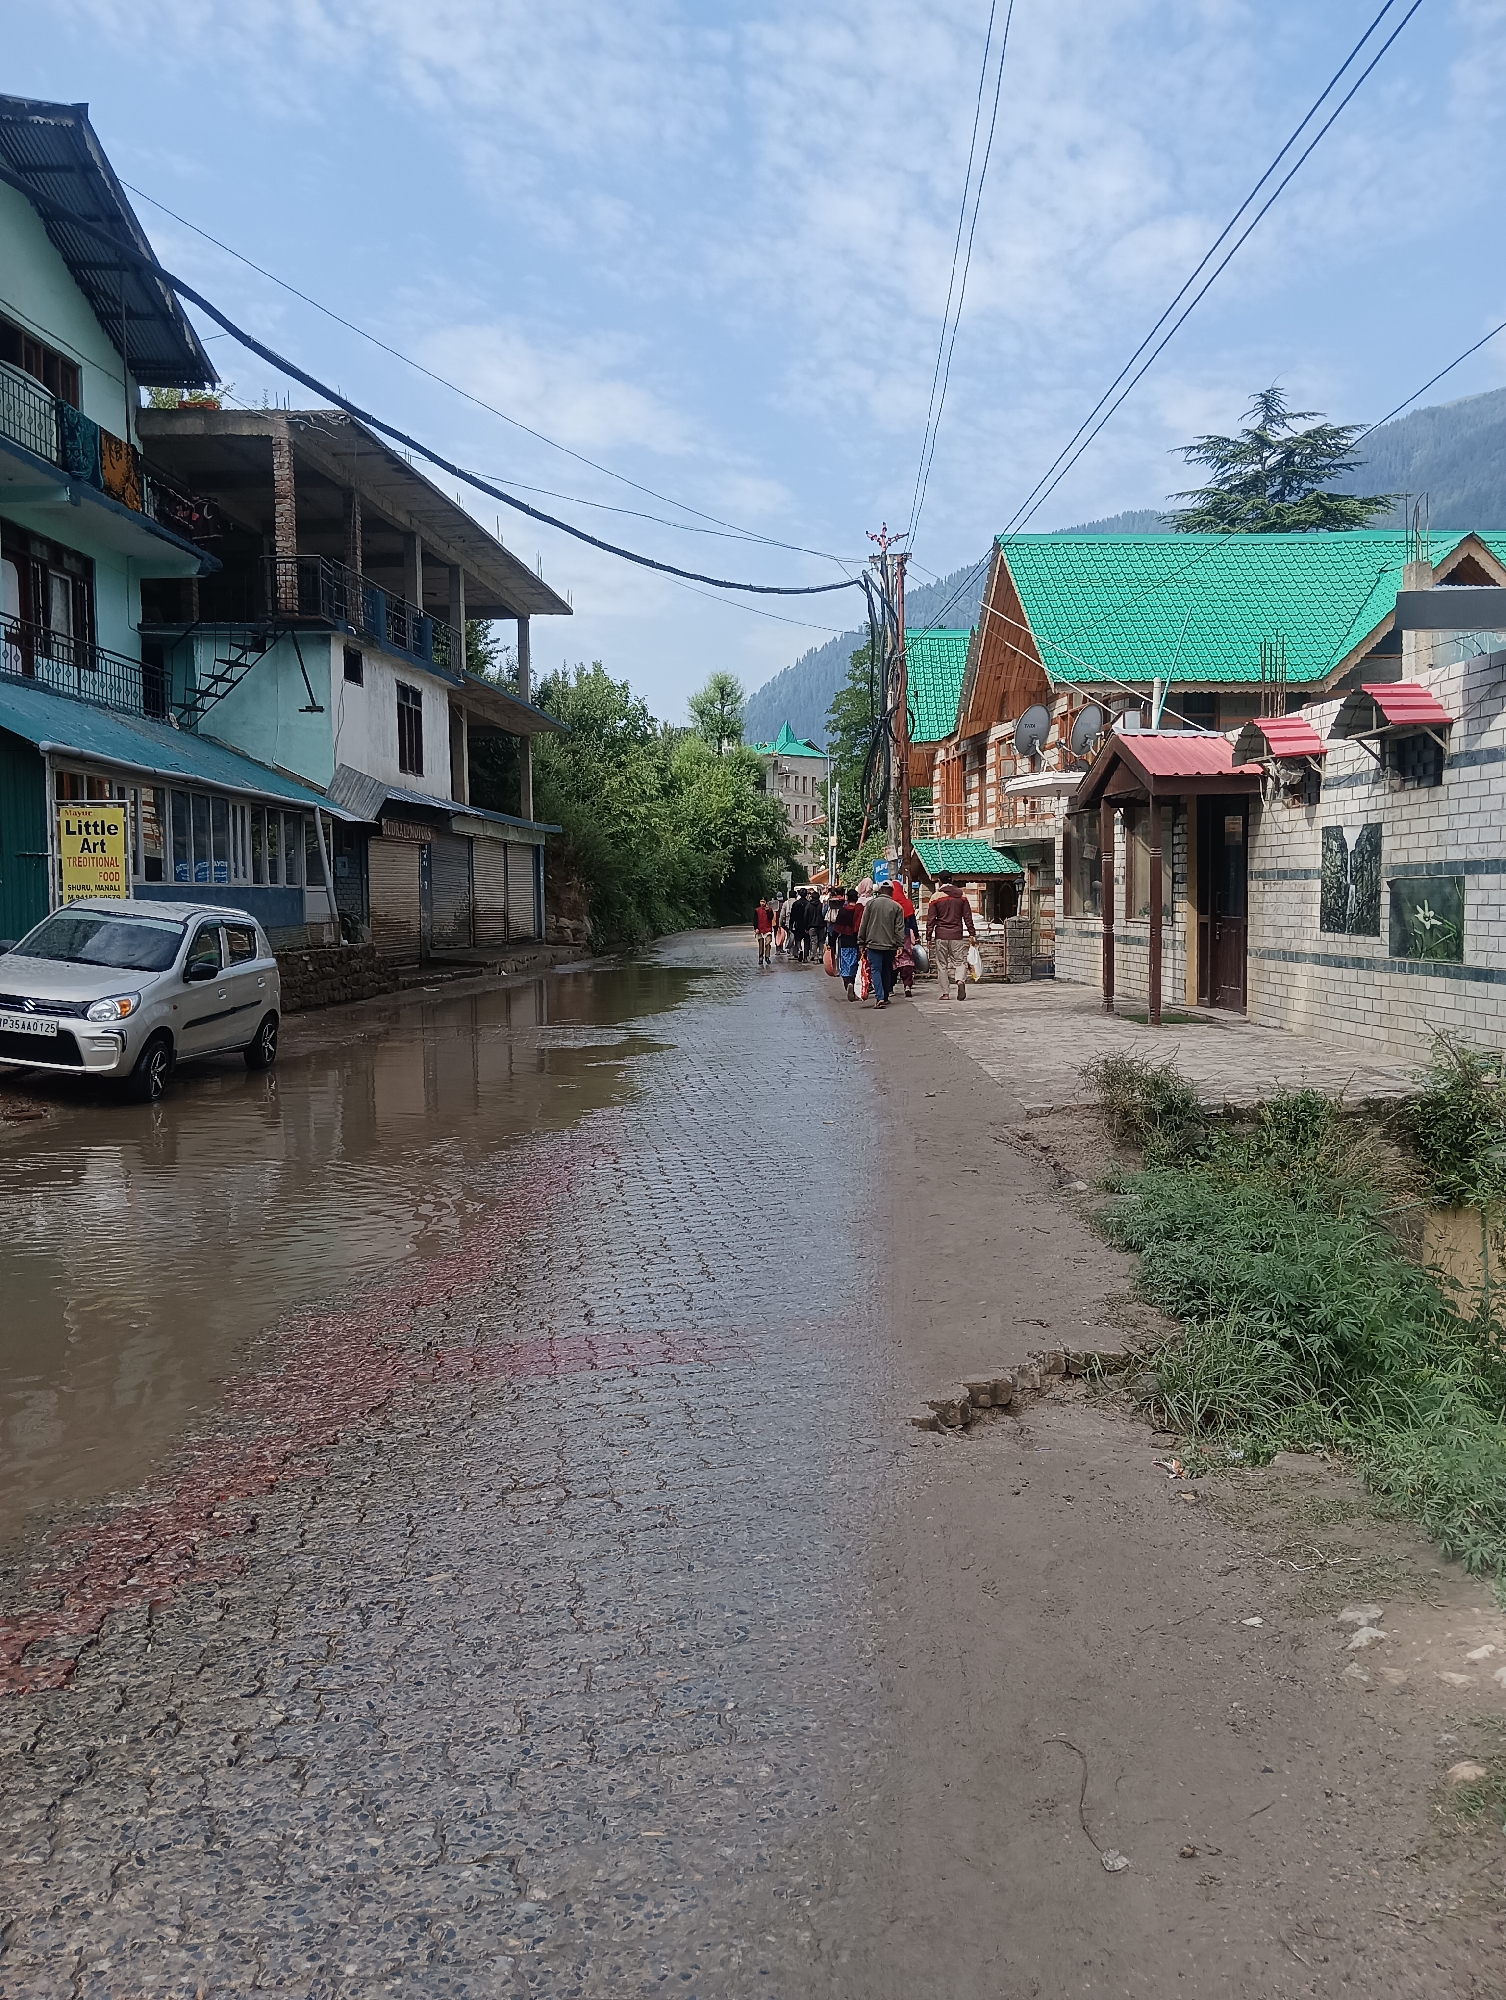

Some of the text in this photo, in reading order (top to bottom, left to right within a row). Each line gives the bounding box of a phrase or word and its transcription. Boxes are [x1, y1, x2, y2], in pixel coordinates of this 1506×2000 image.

[65, 820, 119, 836] Little
[80, 838, 106, 854] Art
[67, 857, 120, 868] TREDITIONAL
[99, 872, 120, 882] FOOD
